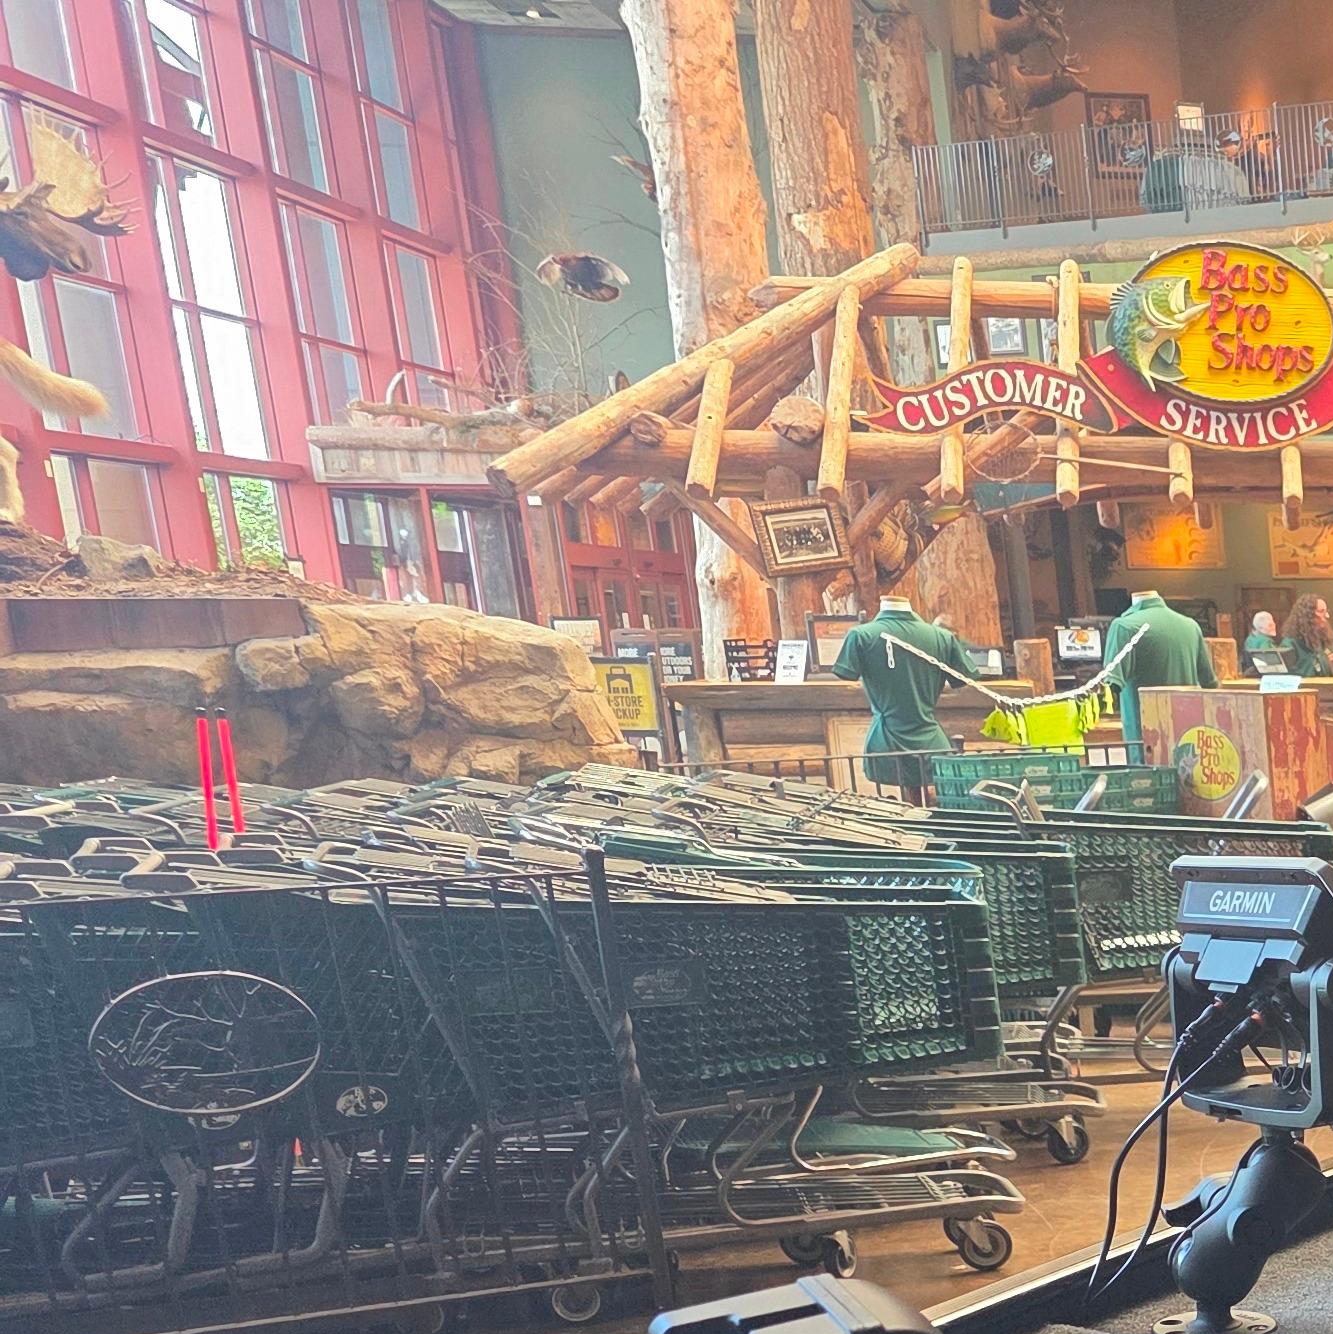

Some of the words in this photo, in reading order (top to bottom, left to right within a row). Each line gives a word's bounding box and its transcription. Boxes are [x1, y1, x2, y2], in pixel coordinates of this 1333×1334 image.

[1198, 249, 1290, 293] Bass
[1206, 291, 1271, 332] Pro
[1208, 331, 1315, 382] Shops
[896, 369, 1087, 431] CUSTOMER
[1160, 398, 1319, 447] SERVICE
[661, 656, 693, 666] UTDOORS
[607, 695, 644, 708] -STORE
[612, 707, 641, 720] CKUP
[1197, 730, 1224, 749] Bass
[1200, 748, 1220, 767] Pro
[1201, 766, 1235, 790] Shops
[1209, 890, 1276, 914] GARMIN
